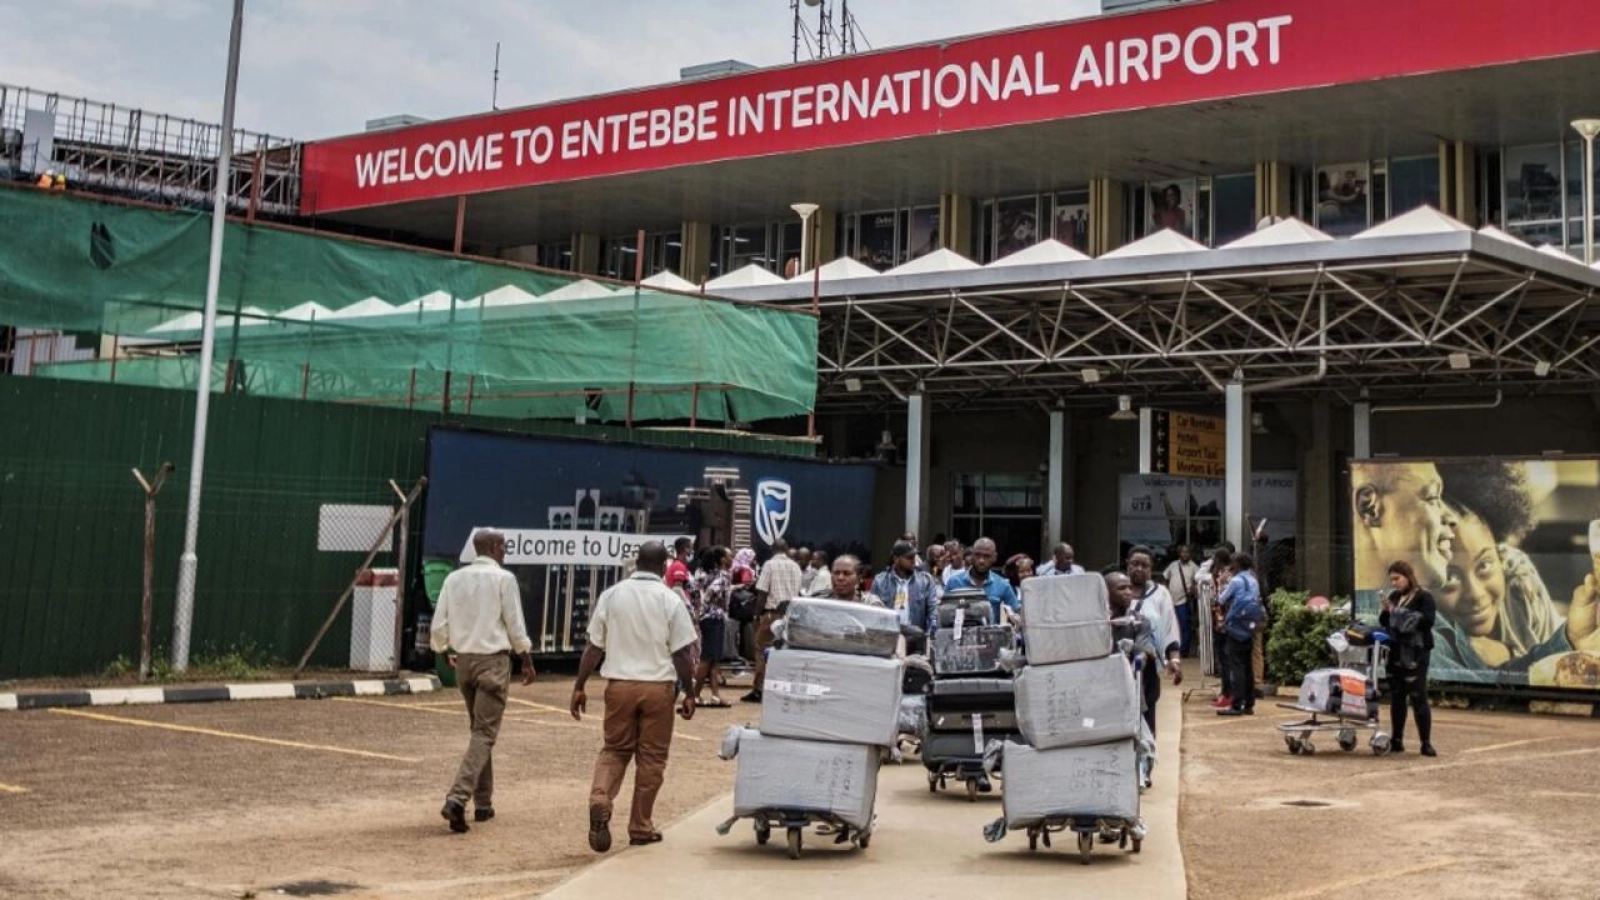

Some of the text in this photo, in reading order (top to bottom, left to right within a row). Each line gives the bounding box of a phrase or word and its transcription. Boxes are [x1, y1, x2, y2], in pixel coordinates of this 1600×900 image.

[355, 15, 1293, 188] WELCOME TO ENTEBBE INTERNATIONAL AIRPORT
[1176, 414, 1216, 430] Car Rentals
[1176, 446, 1202, 460] Airport
[1143, 478, 1185, 488] Welcome
[1263, 478, 1294, 488] Africa
[505, 533, 677, 560] elcome to Ugaa
